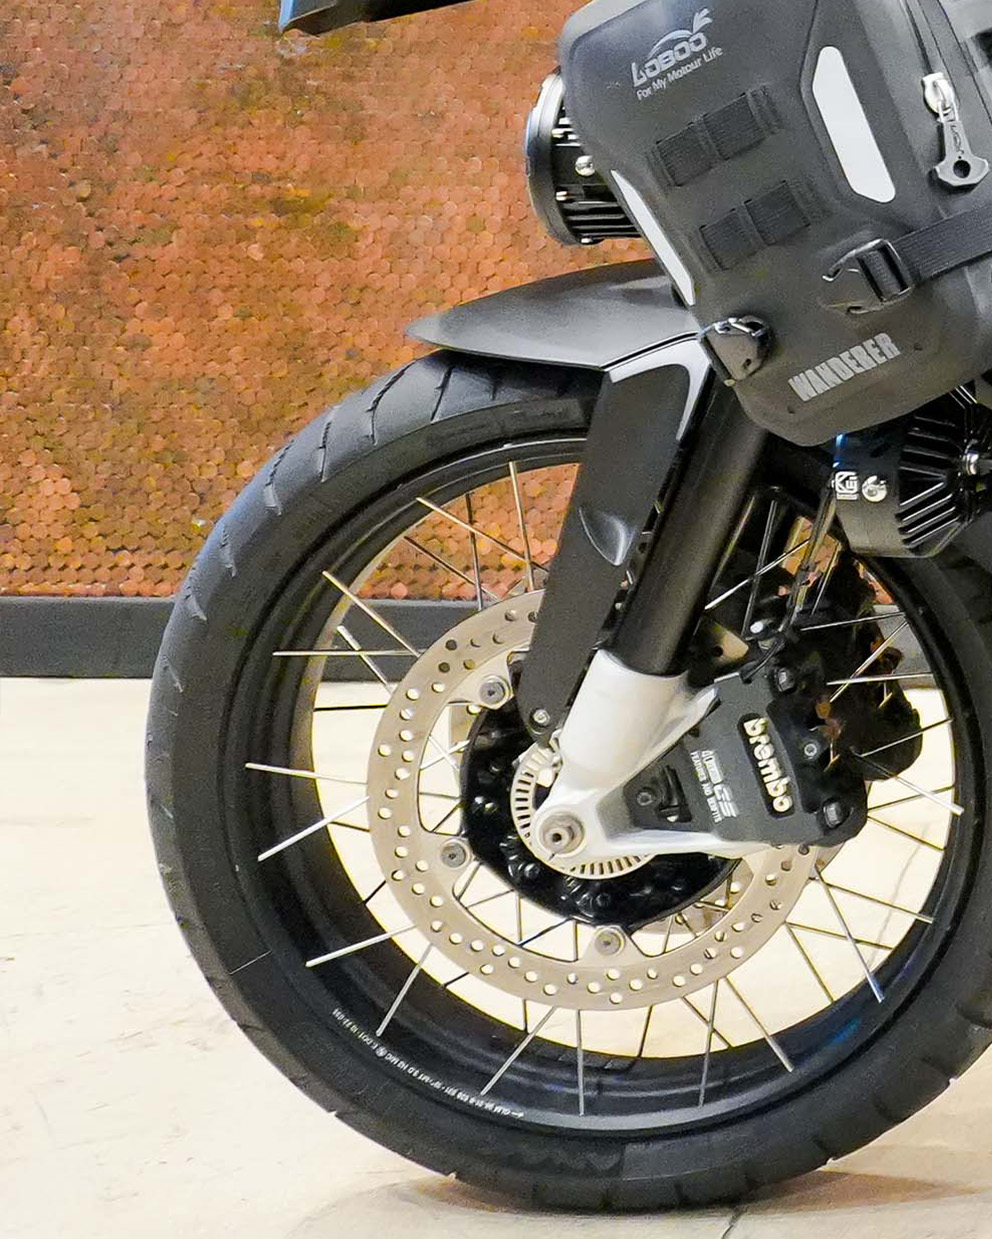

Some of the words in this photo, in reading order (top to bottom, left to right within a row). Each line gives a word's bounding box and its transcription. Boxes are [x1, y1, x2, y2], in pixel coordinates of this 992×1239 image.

[631, 31, 708, 88] LOBOO
[636, 86, 653, 100] For
[651, 77, 668, 90] My
[666, 58, 703, 82] Motour
[702, 46, 724, 63] Life
[787, 332, 901, 402] WANDERER
[743, 716, 794, 813] brembo
